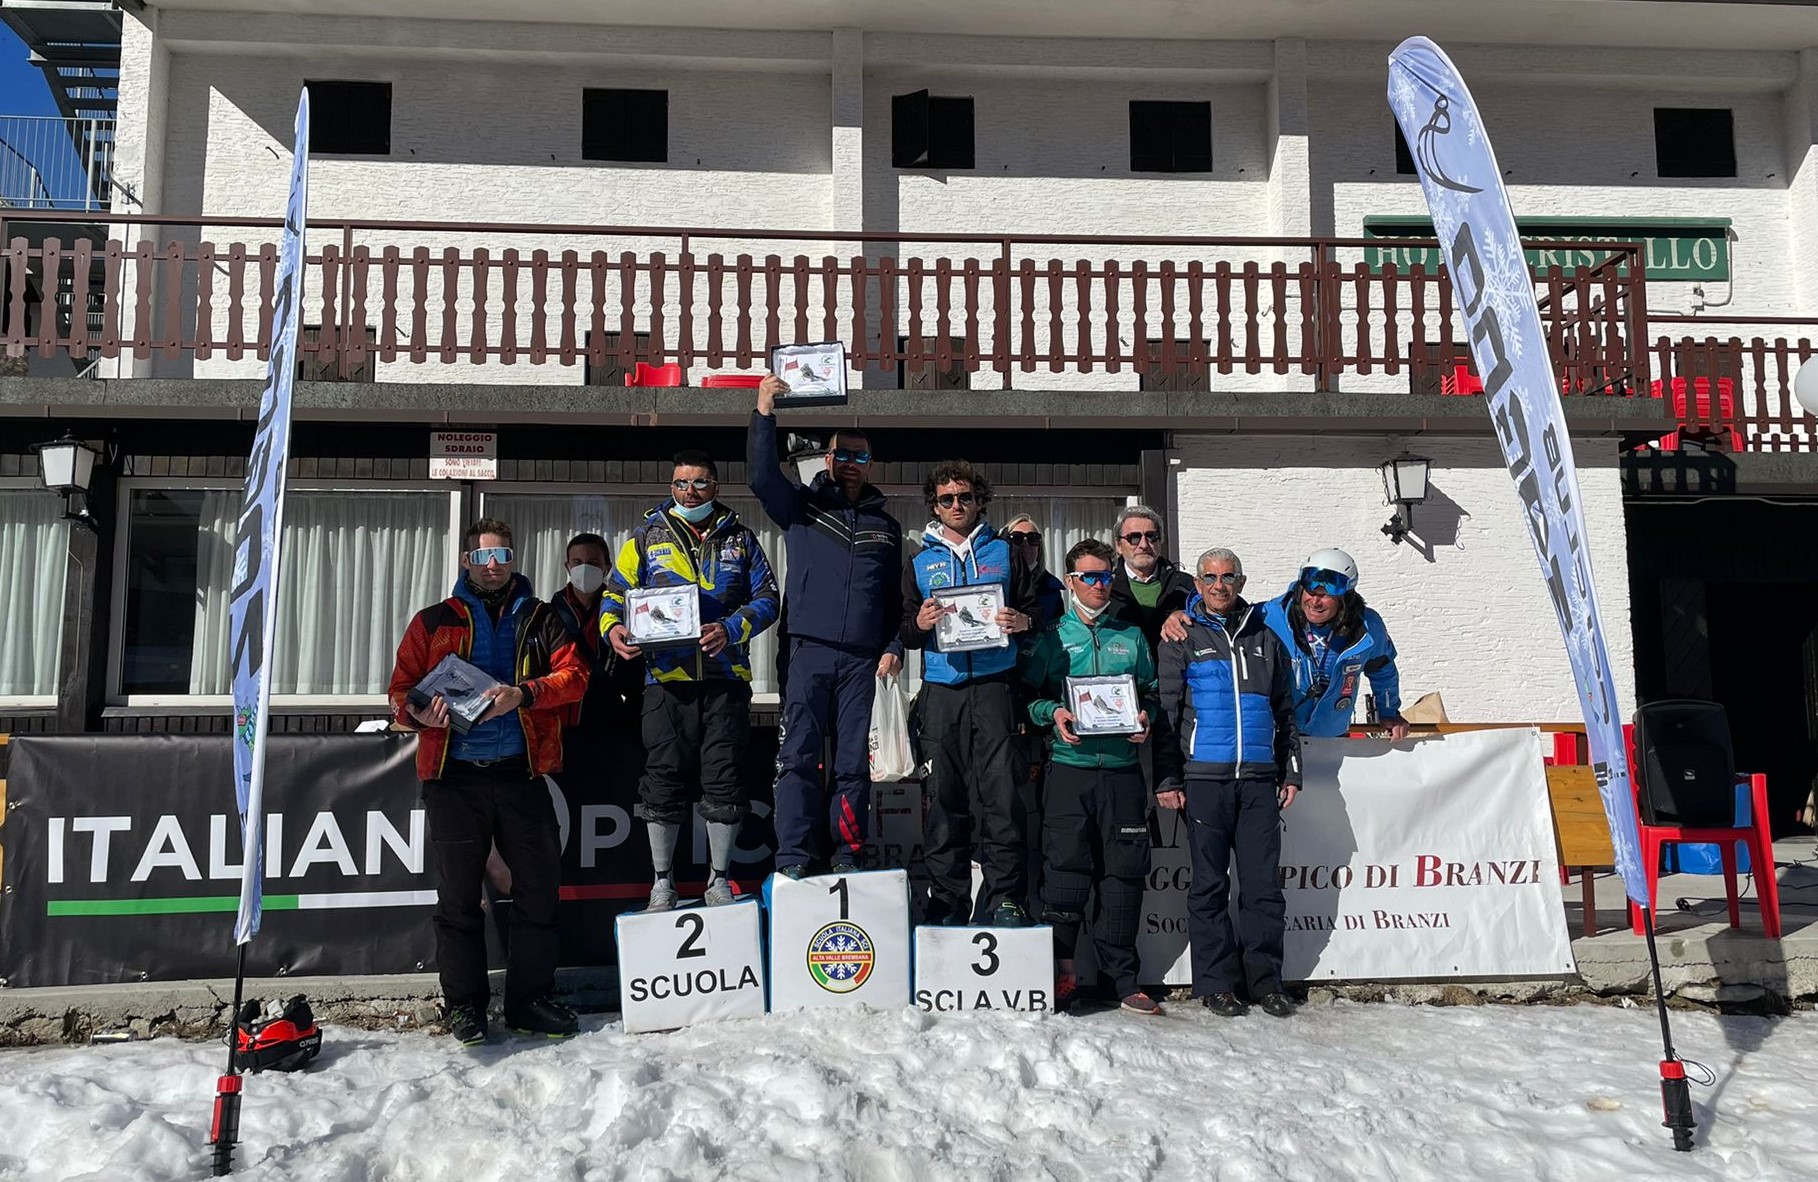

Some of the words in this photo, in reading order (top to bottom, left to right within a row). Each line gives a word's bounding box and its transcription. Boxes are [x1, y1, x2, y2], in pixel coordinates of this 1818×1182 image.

[438, 433, 492, 442] NOLEGGIO
[445, 445, 485, 453] SDRAIO
[47, 808, 426, 884] ITALIAN
[1278, 863, 1353, 890] PICO
[1364, 863, 1400, 889] DI
[1413, 853, 1542, 889] BRANZI
[828, 877, 849, 920] 1
[675, 912, 706, 959] 2
[814, 928, 834, 949] SCUOLA
[1344, 913, 1367, 932] DI
[1372, 908, 1452, 930] BRANZI
[971, 931, 1000, 977] 3
[629, 964, 760, 1003] SCUOLA
[916, 989, 963, 1013] SCI
